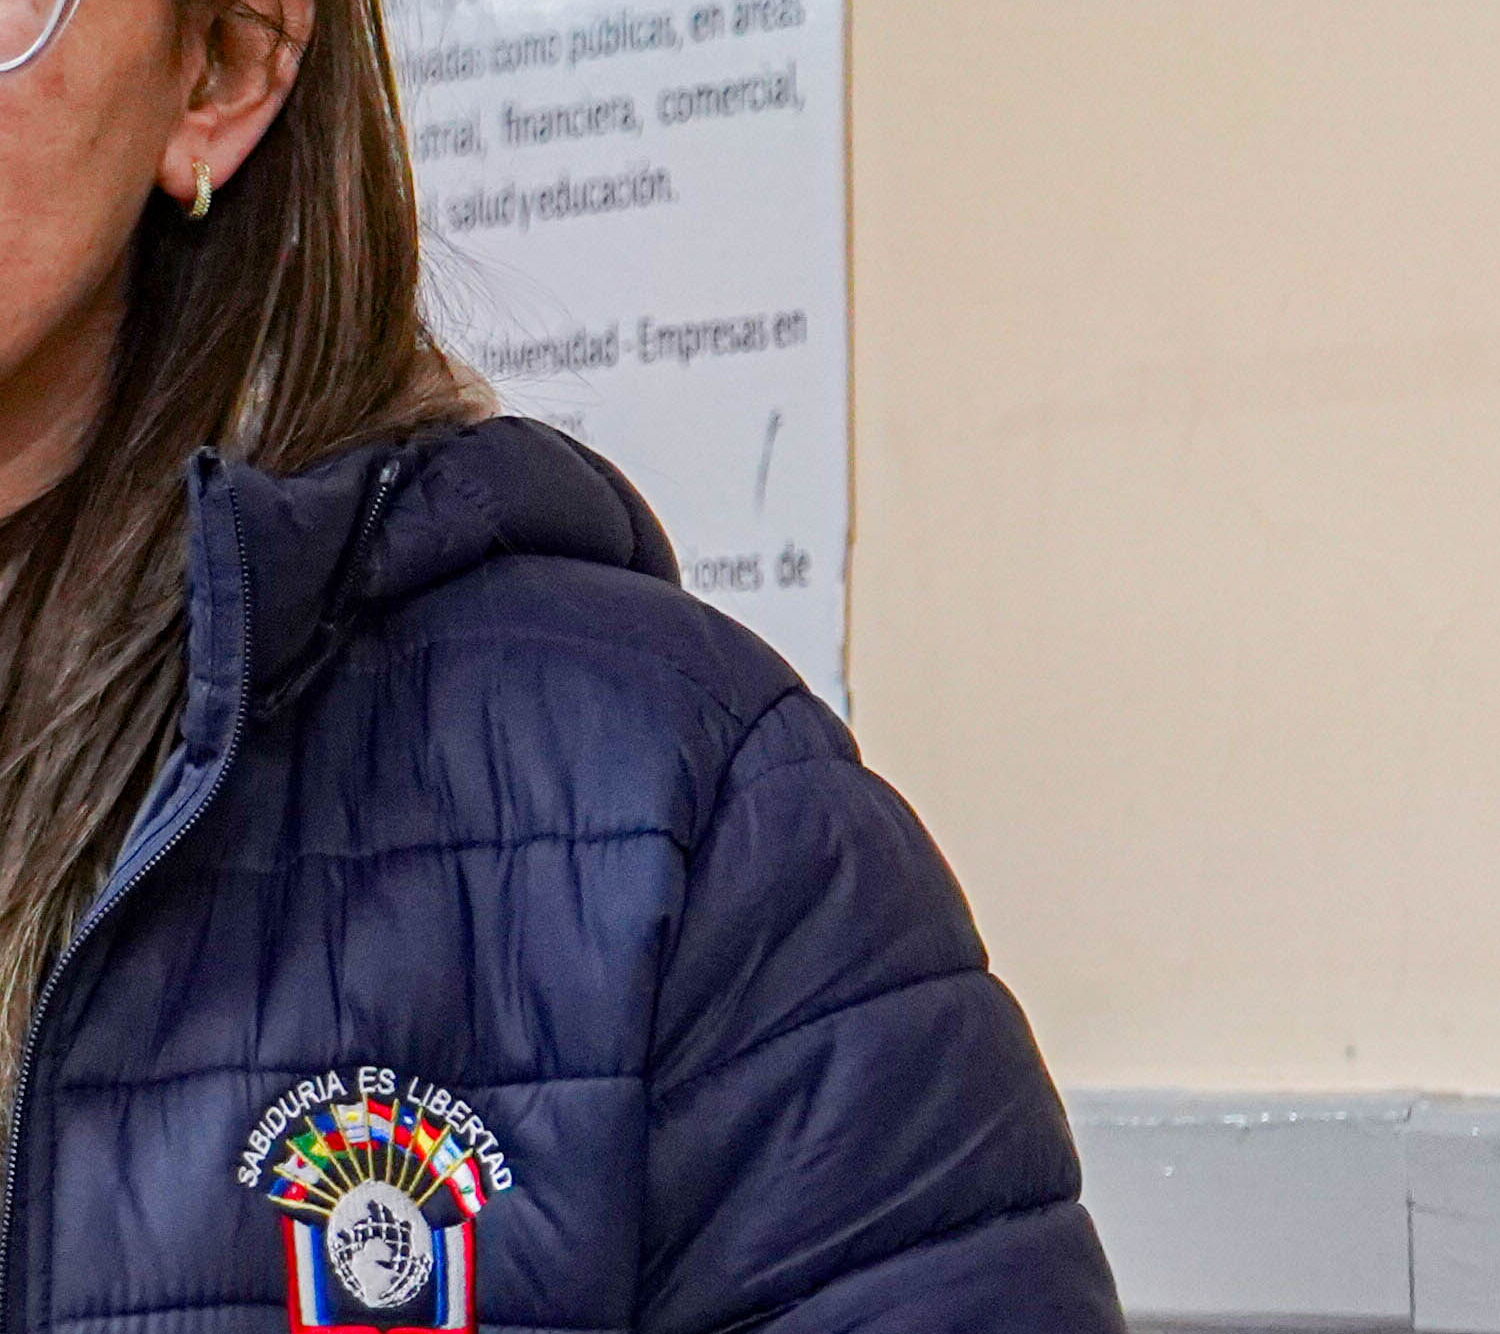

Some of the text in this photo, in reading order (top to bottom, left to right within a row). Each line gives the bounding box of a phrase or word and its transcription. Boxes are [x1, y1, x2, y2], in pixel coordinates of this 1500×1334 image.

[688, 3, 725, 43] en
[657, 62, 806, 126] comercial,
[637, 313, 769, 365] Empresas
[772, 308, 808, 349] en
[777, 538, 813, 589] de
[237, 1066, 513, 1191] SABIDURIA ES LIBERTAD
